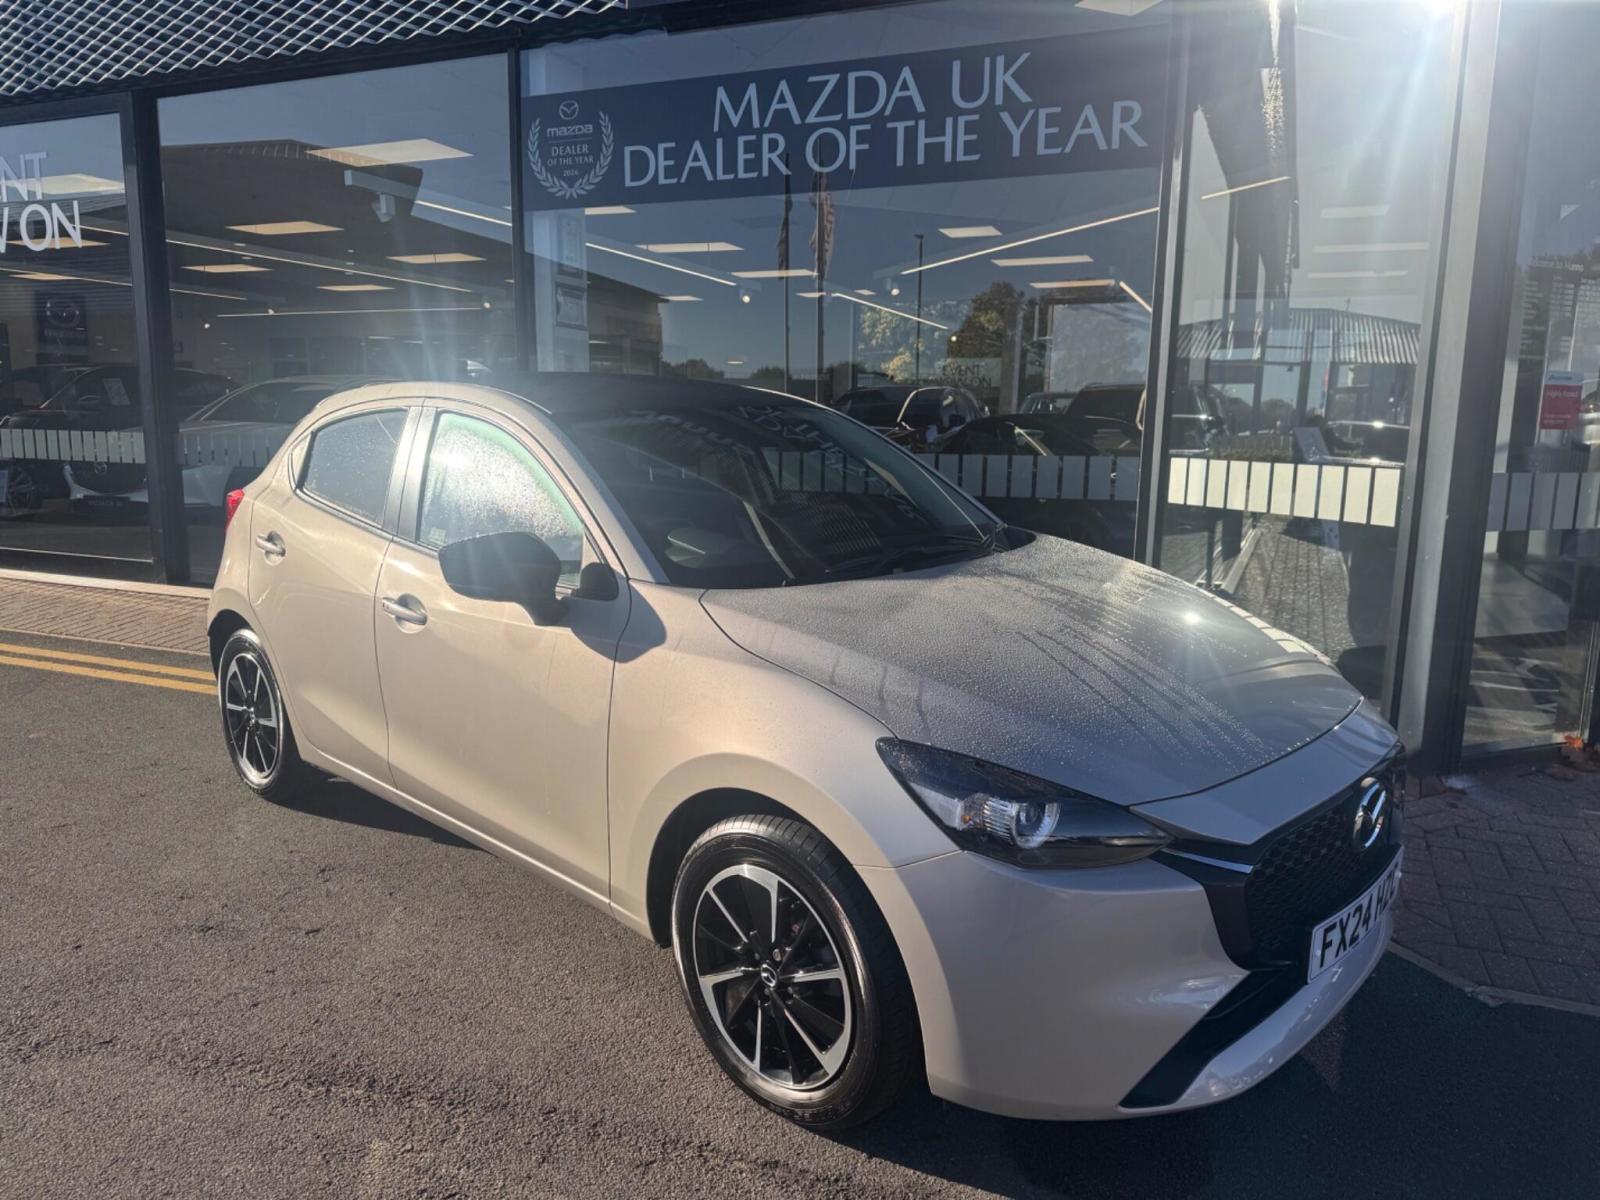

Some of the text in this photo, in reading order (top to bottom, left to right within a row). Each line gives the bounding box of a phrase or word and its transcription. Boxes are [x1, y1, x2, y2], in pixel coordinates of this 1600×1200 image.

[713, 52, 1032, 132] MAZDA UK
[547, 125, 592, 137] mazda
[552, 144, 589, 156] DEALER
[623, 100, 1148, 187] DEALER OF THE YEAR
[559, 157, 572, 166] THE
[574, 155, 593, 165] YEAR
[20, 200, 82, 251] ON
[1320, 894, 1373, 968] FX24
